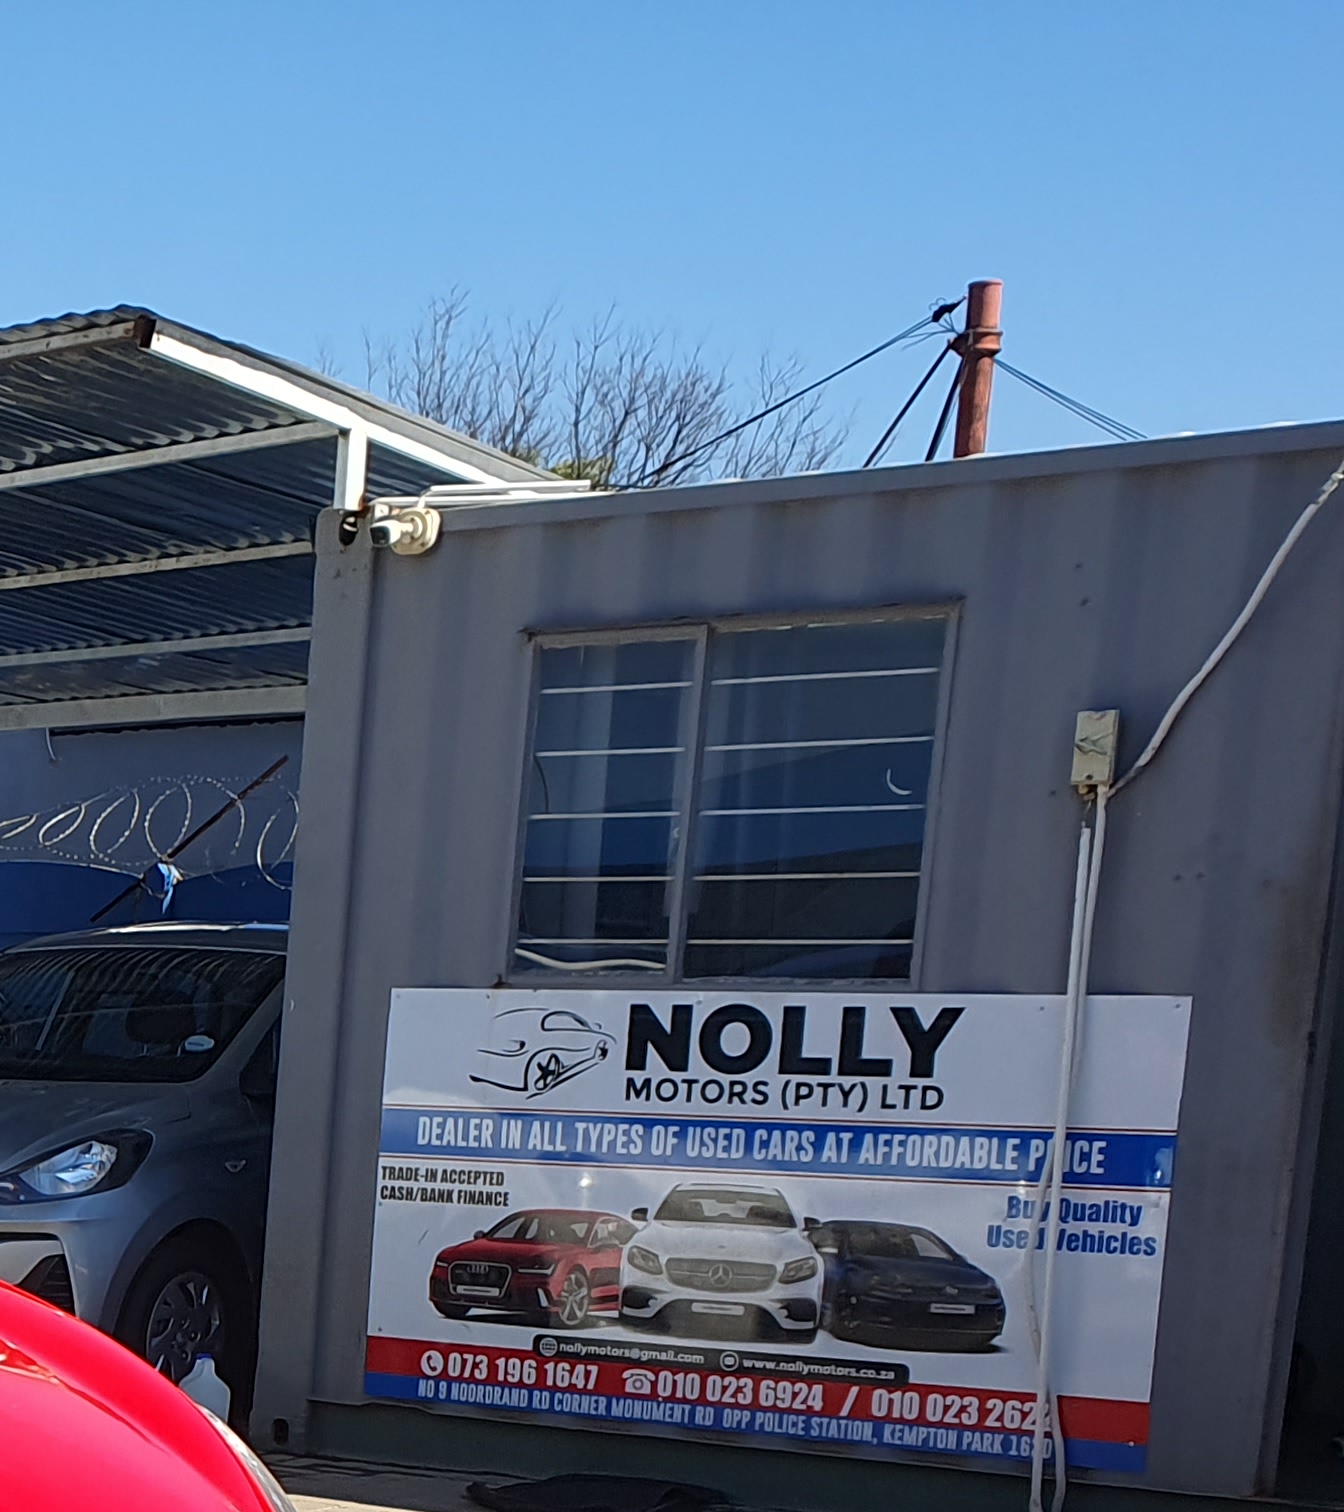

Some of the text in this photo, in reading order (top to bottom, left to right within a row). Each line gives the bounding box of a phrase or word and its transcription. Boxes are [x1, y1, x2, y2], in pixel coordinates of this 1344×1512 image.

[625, 1003, 967, 1079] NOLLY
[625, 1077, 945, 1113] MOTORS (PTY) LTD
[417, 1116, 1107, 1174] DEALER IN ALL TYPES OF USED CARS AT AFFORDABLE PICE
[380, 1165, 505, 1187] TRADE-IN ACCEPTED
[380, 1185, 510, 1208] CASH/BANK FINANCE
[1058, 1197, 1143, 1227] Quality
[447, 1352, 599, 1390] 073 196 1647
[559, 1341, 705, 1365] nollymotors@gmail.com
[742, 1358, 895, 1381] www.nollymotors.co.za
[657, 1370, 700, 1401] 010
[706, 1374, 753, 1405] 023
[759, 1381, 824, 1412] 6924
[871, 1388, 919, 1420] 010
[926, 1393, 979, 1426] 023
[417, 1378, 1052, 1459] NO 9 NOORDRAND RD CORNER MONUMENT RD OPP POLICE STATION, KEMPTON PARK 160
